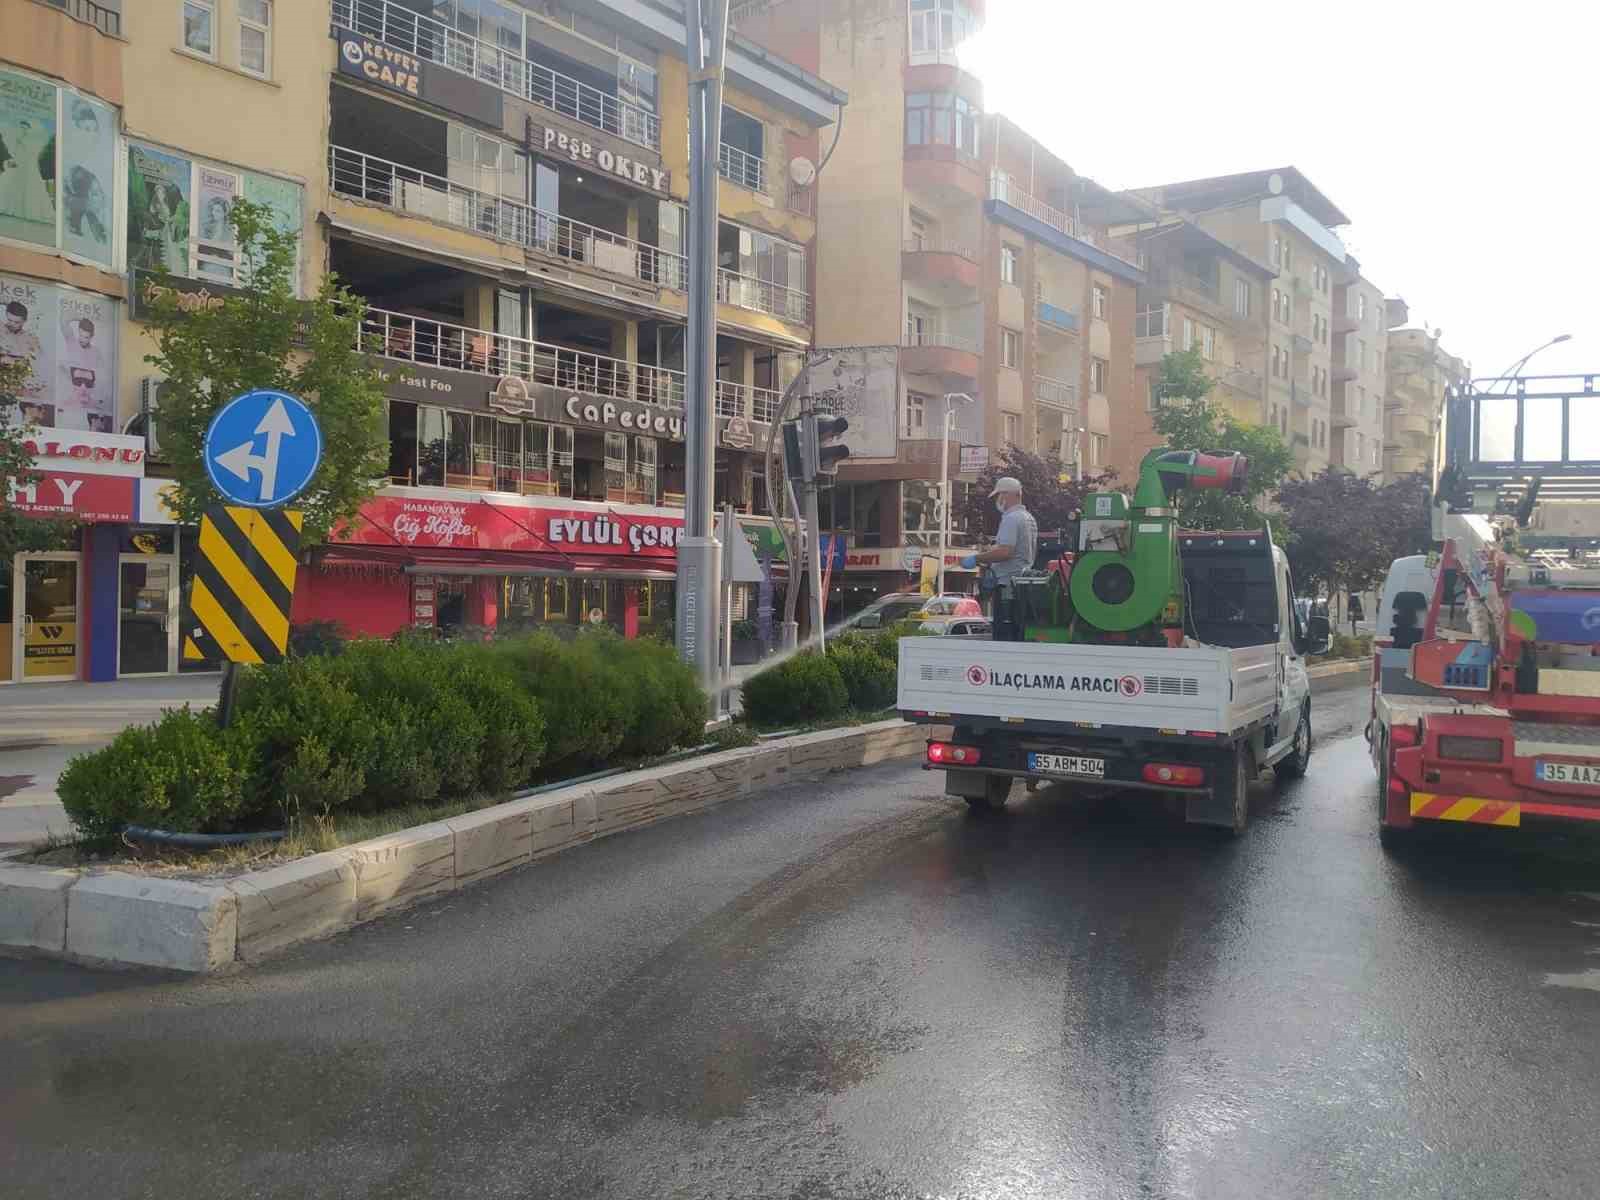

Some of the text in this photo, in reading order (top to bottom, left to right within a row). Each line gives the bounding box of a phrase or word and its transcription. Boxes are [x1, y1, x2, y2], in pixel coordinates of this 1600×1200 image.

[363, 60, 418, 96] CAFE
[598, 149, 665, 190] OKEY
[430, 379, 452, 393] Foo
[393, 513, 472, 542] Çiğ Köfte
[549, 516, 623, 545] EYLÜL
[990, 669, 1118, 693] İLAÇLAMA ARACI
[1036, 755, 1050, 769] 65
[1054, 757, 1078, 770] ABM
[1080, 759, 1104, 773] 504
[1546, 764, 1600, 783] 35 AAZ
